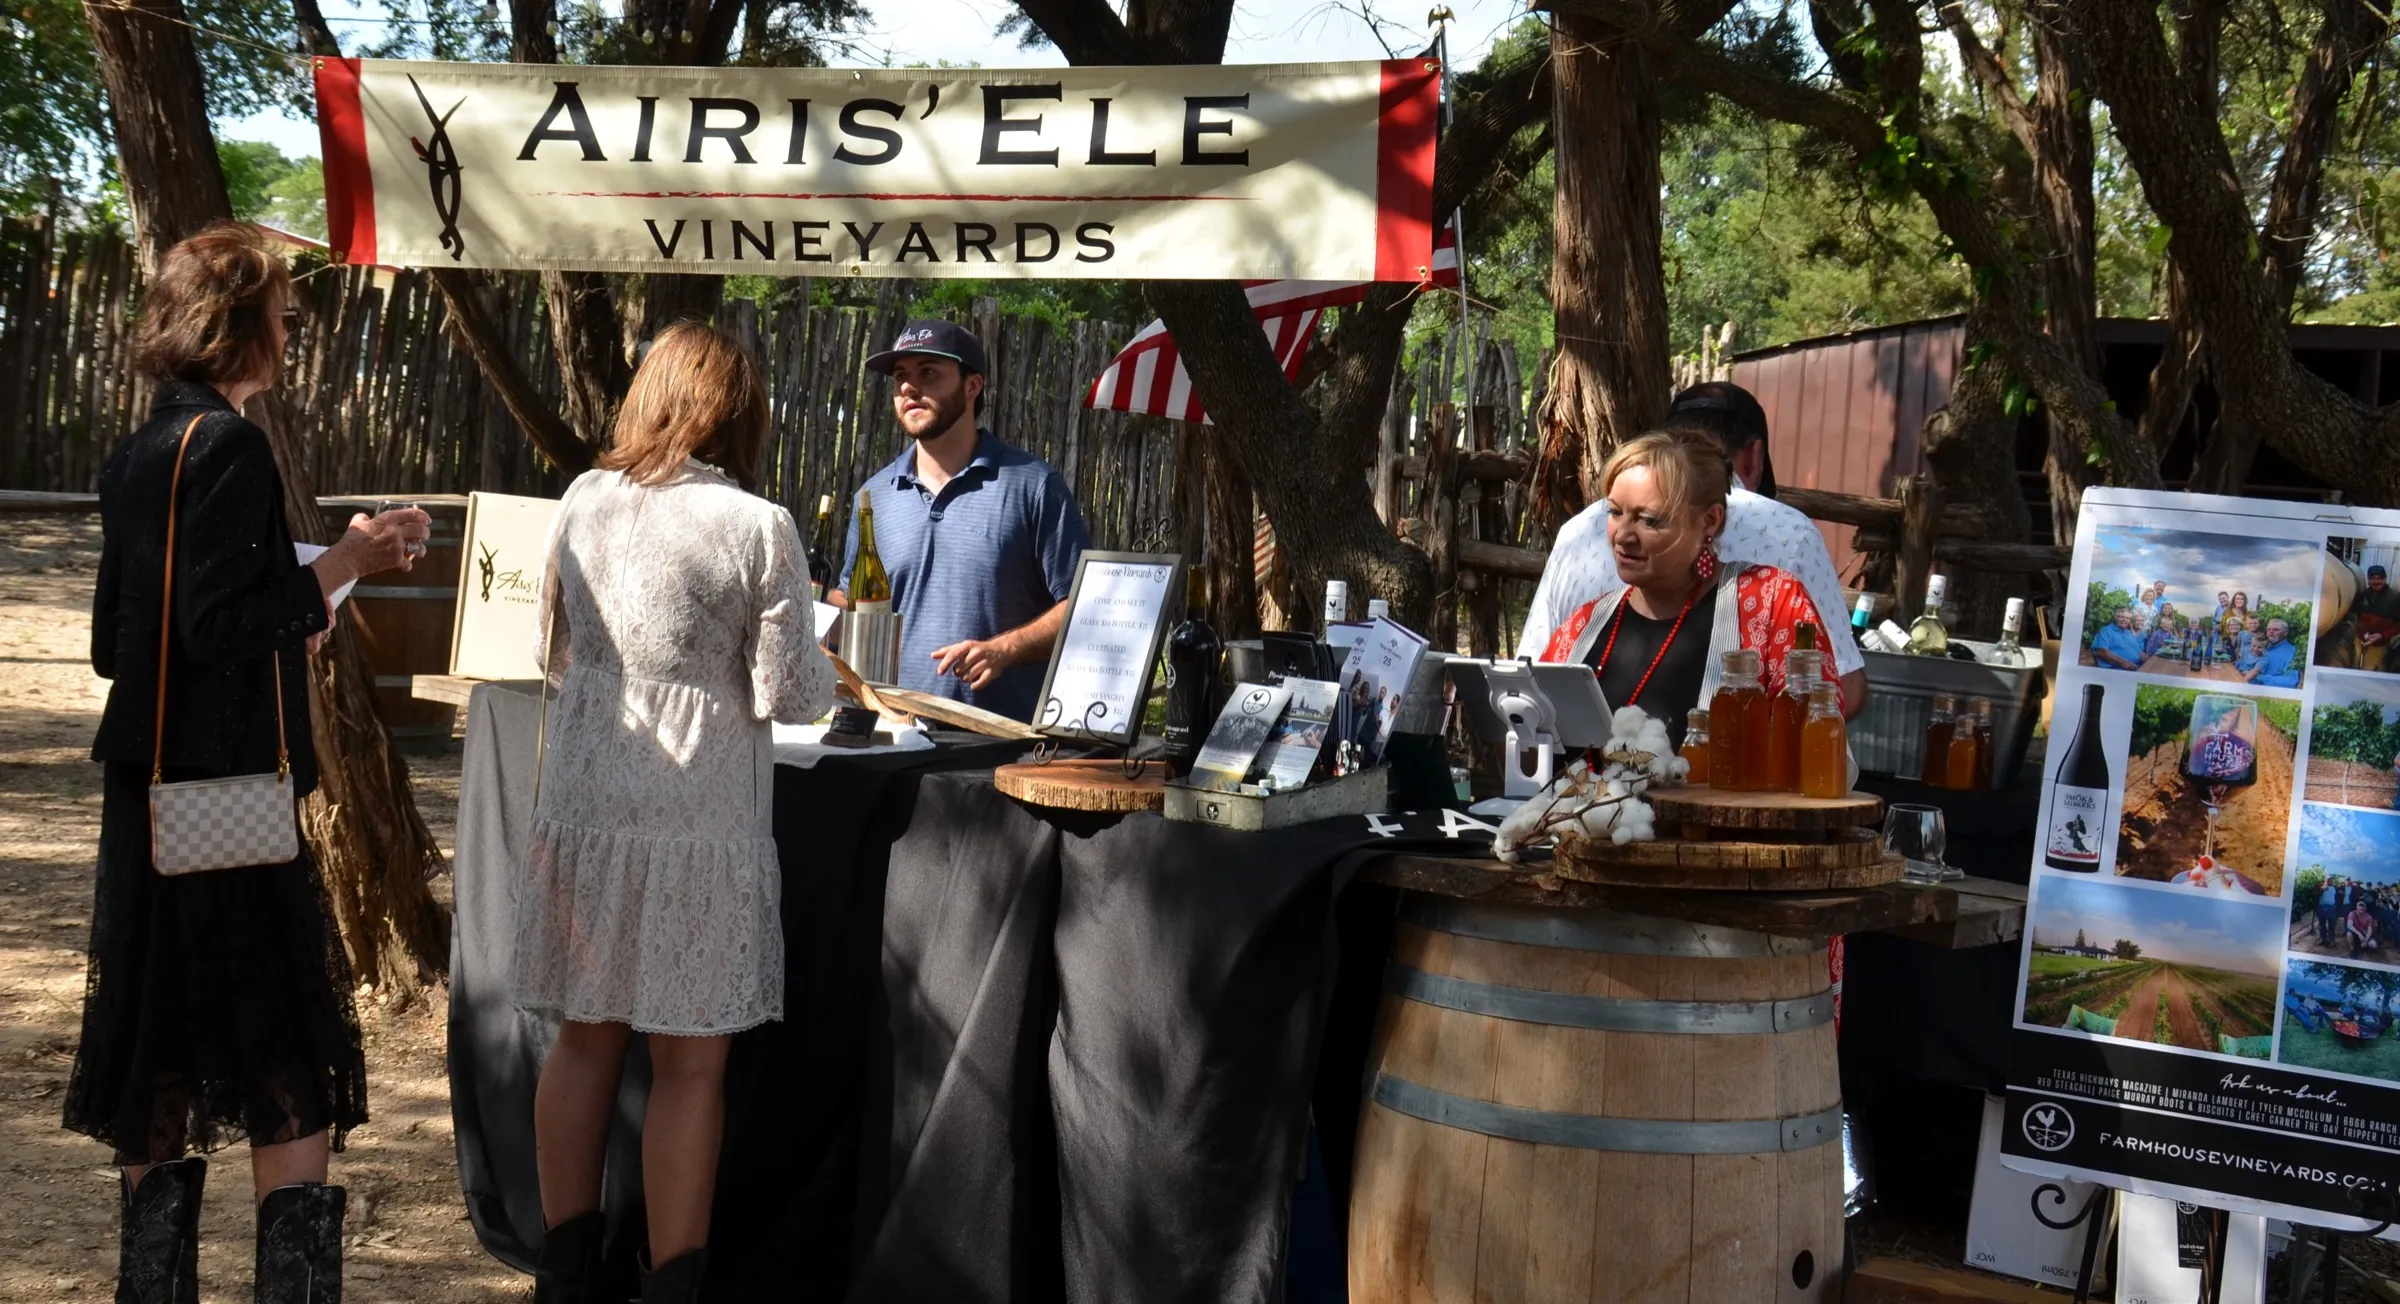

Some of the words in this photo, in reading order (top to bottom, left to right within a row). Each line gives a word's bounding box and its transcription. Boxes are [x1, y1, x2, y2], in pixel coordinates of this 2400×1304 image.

[643, 218, 1116, 264] VINEYARDS
[1382, 655, 1393, 668] 25
[2204, 741, 2244, 757] FARM
[2220, 1073, 2254, 1091] Ask
[2255, 1084, 2281, 1095] us
[2036, 1076, 2052, 1088] RED
[2098, 1086, 2121, 1100] PAIGE
[2123, 1090, 2157, 1105] MURRAY
[2159, 1096, 2185, 1110] BOOTS
[2187, 1101, 2194, 1112] &
[2197, 1102, 2236, 1118] BISCUITS
[2245, 1110, 2266, 1123] CHET
[2269, 1114, 2301, 1129] GARNER
[2304, 1120, 2320, 1133] THE
[2323, 1123, 2340, 1136] DAY
[2343, 1126, 2378, 1142] TRIPPER
[2388, 1134, 2400, 1147] TE
[2053, 1068, 2077, 1081] TEXAS
[2079, 1073, 2120, 1089] HIGHWAYS
[2122, 1079, 2163, 1096] MAGAZINE
[2172, 1087, 2209, 1104] MIRANDA
[2211, 1094, 2248, 1110] LAMBERT
[2259, 1101, 2284, 1116] TYLER
[2286, 1106, 2333, 1124] MCCOLLUM
[2369, 1120, 2398, 1134] RANCH
[2099, 1132, 2387, 1193] FARMHOUSEVINEYARDS.CO
[1974, 1251, 1997, 1265] WCF
[2040, 1264, 2070, 1279] 750ml
